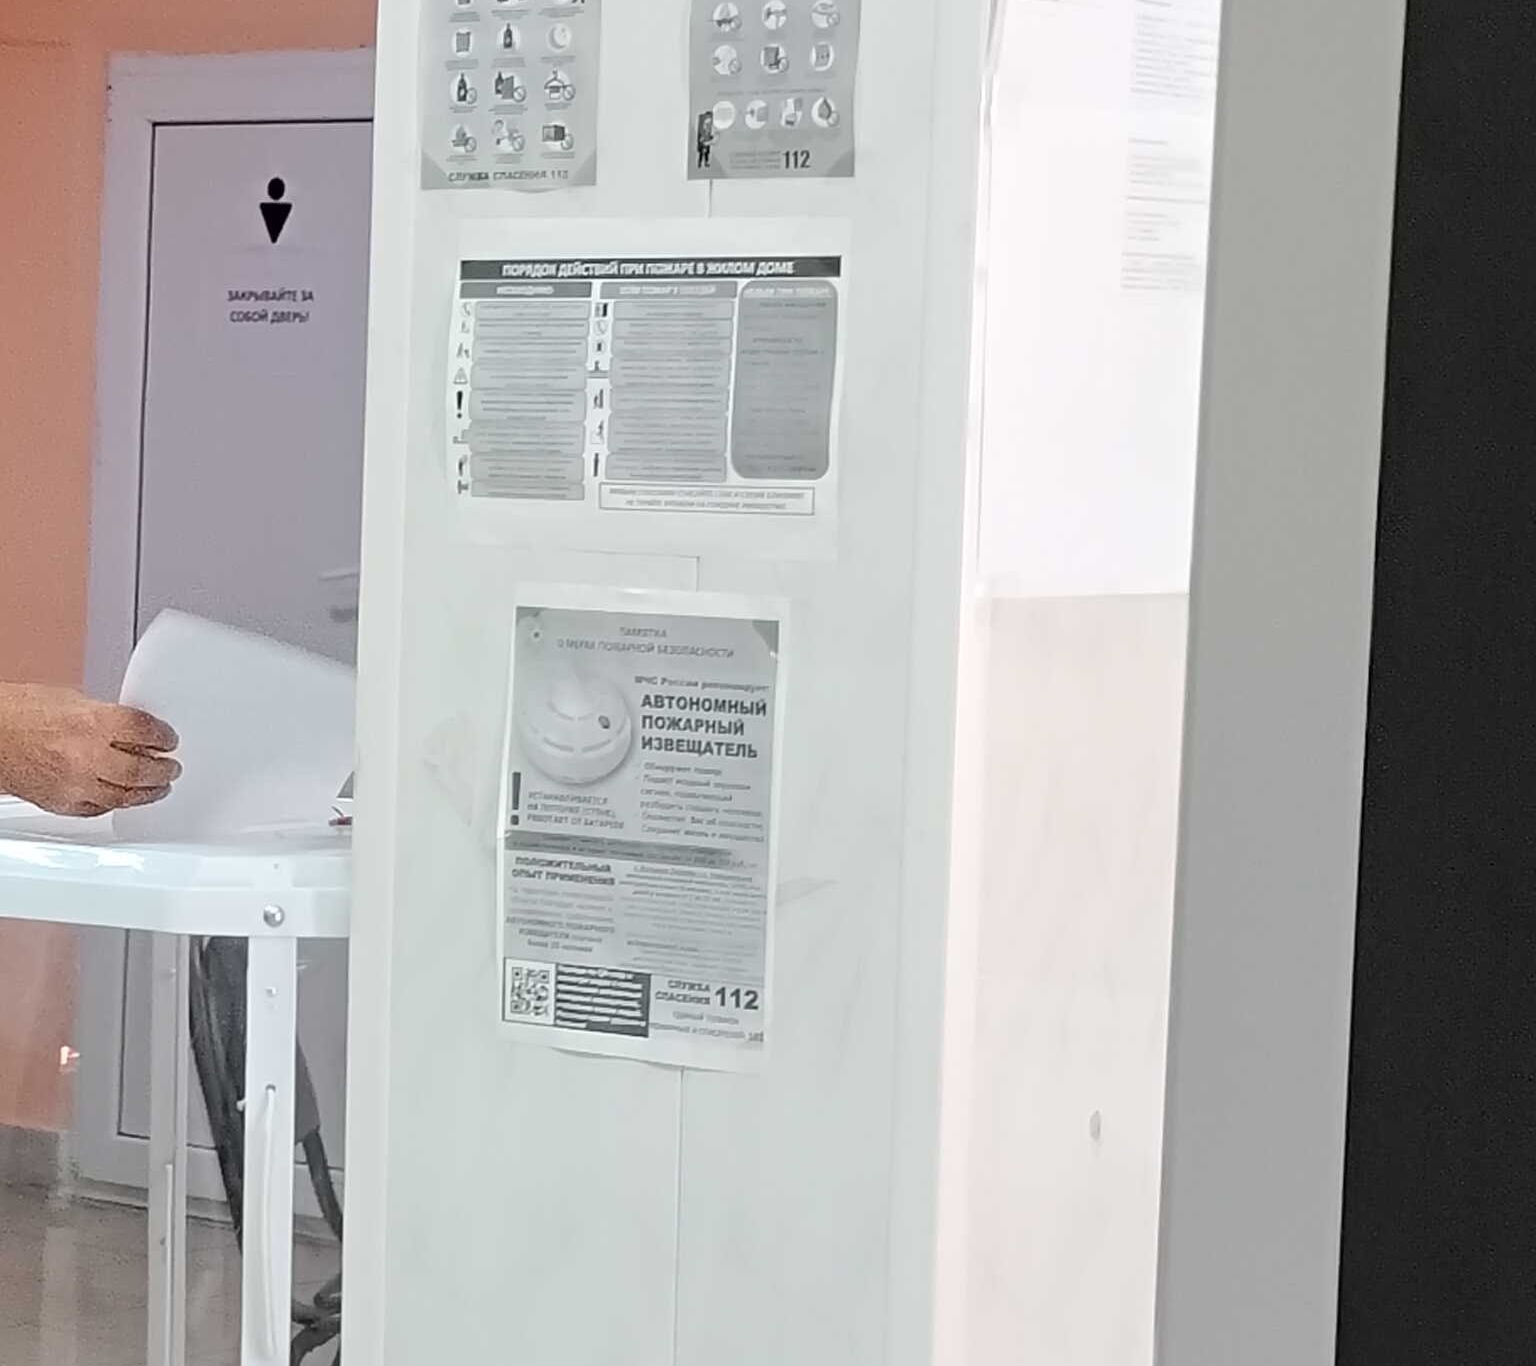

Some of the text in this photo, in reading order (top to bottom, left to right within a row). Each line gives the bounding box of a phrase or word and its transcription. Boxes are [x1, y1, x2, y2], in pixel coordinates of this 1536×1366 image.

[782, 150, 811, 169] 112
[501, 261, 795, 277] ПОРЯДОК ДЕЙСТВИЙ ПРИ ПОЖАРЕ В ЖИЛОМ ДОМЕ
[227, 288, 314, 302] ЗАКРЫВАЙТЕ ЗА
[229, 309, 268, 323] СОБОЙ
[640, 694, 767, 716] АВТОНОМНЫЙ
[642, 715, 744, 736] ПОЖАРНЫЙ
[641, 735, 758, 758] ИЗВЕЩАТЕЛЬ
[715, 986, 759, 1010] 112
